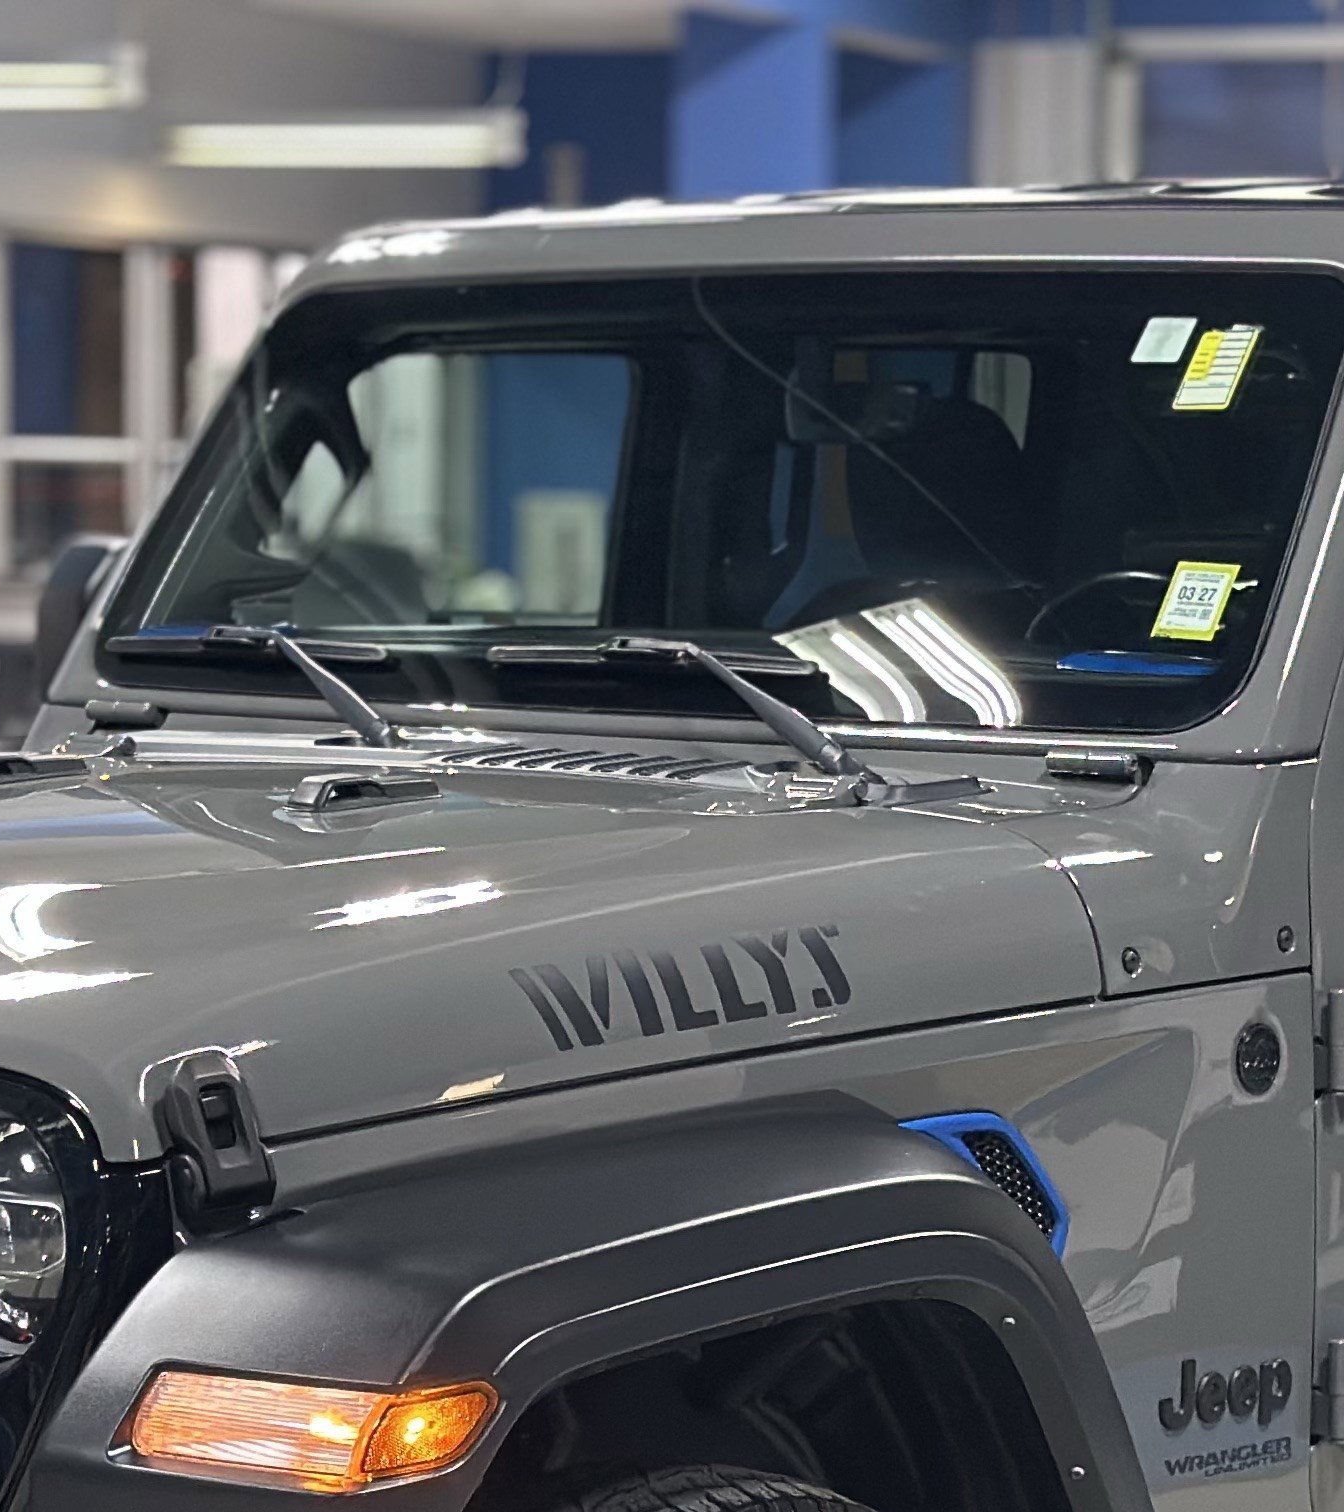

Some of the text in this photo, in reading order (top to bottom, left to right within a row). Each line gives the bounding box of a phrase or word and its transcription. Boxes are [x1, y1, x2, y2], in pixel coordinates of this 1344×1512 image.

[1177, 585, 1219, 602] 03 27
[508, 923, 851, 1051] WILLYS
[1158, 1357, 1293, 1432] Jeep
[1164, 1436, 1291, 1476] WRANGLER
